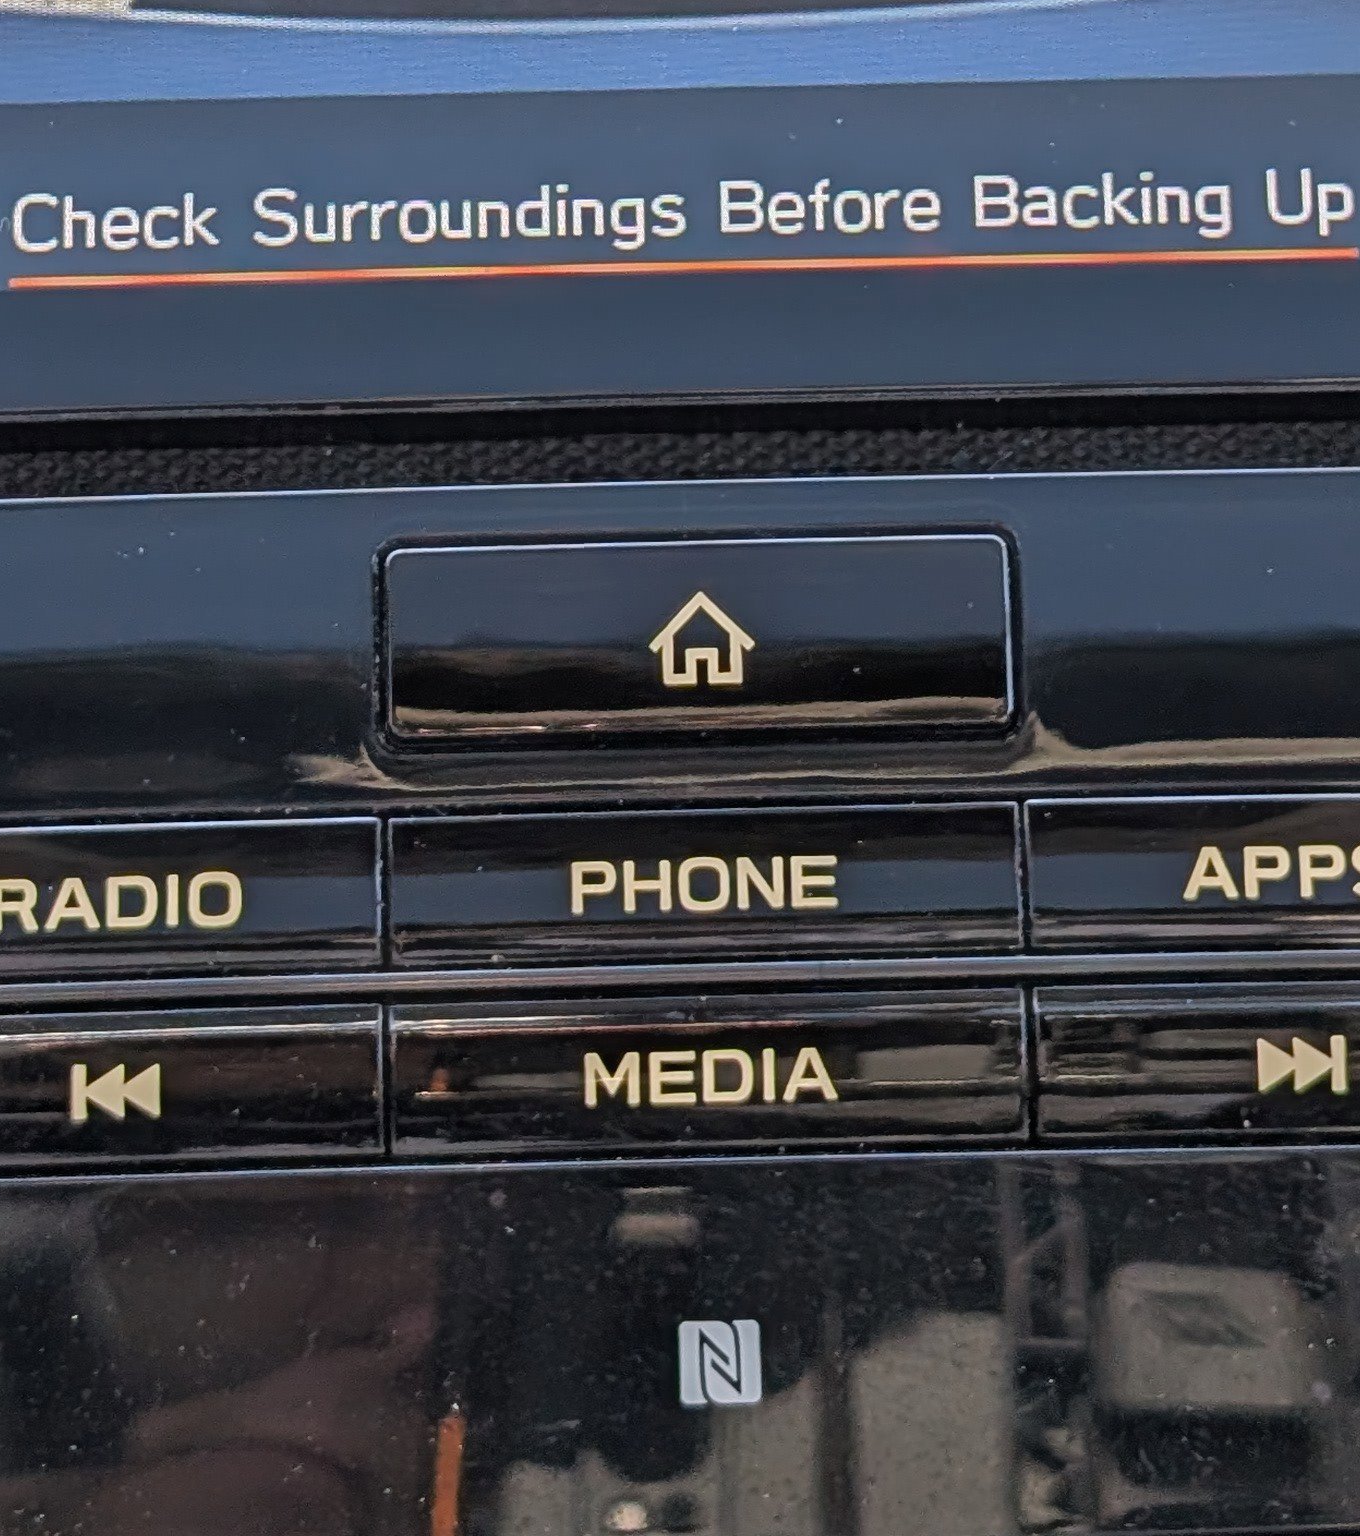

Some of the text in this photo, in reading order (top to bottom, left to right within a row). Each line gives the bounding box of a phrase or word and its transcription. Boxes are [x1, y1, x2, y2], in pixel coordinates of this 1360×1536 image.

[11, 166, 1355, 253] Check Surroundings Before Backing Up
[569, 854, 839, 917] PHONE
[583, 1046, 839, 1109] MEDIA
